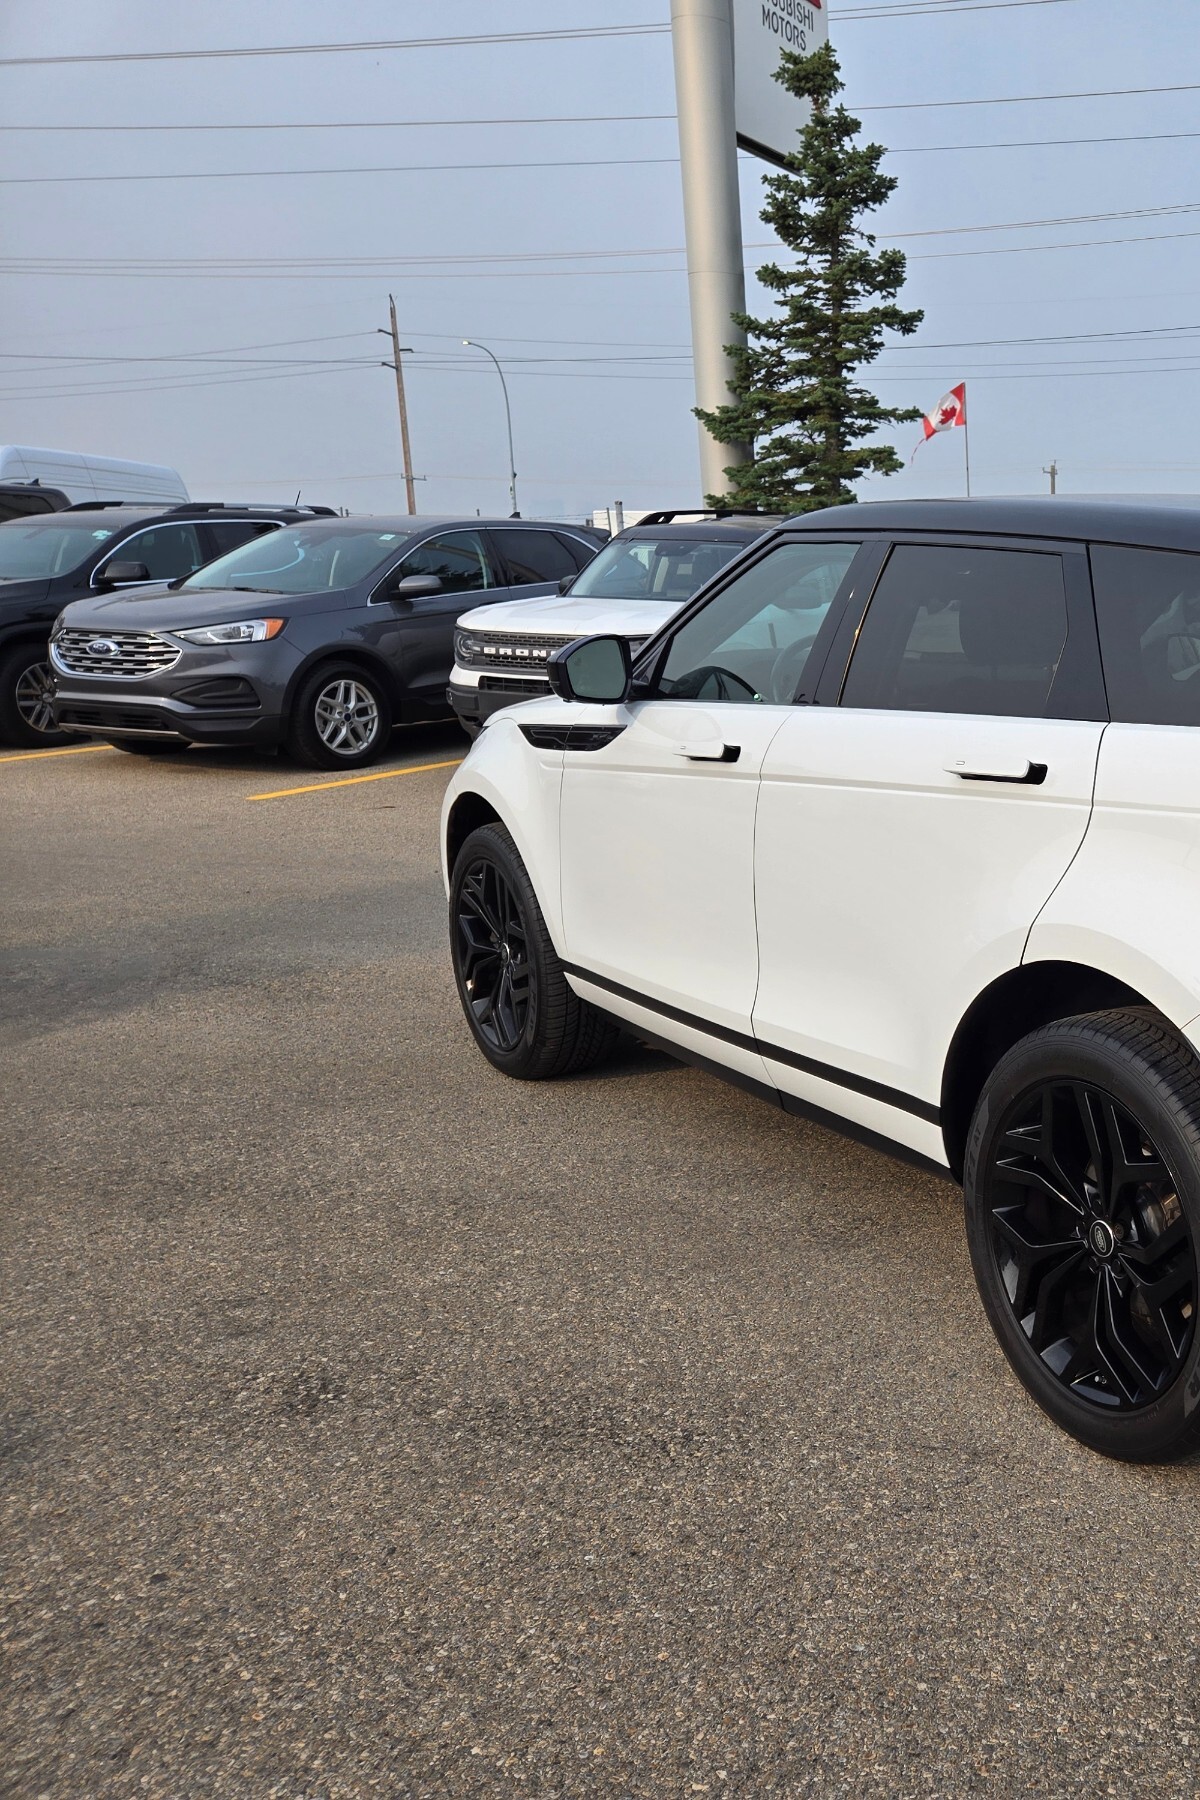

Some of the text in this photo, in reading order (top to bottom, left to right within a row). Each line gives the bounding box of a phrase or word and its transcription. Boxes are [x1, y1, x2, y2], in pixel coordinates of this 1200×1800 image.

[761, 4, 806, 51] MOTORS
[767, 0, 814, 32] UBISHI
[483, 646, 557, 657] BRON
